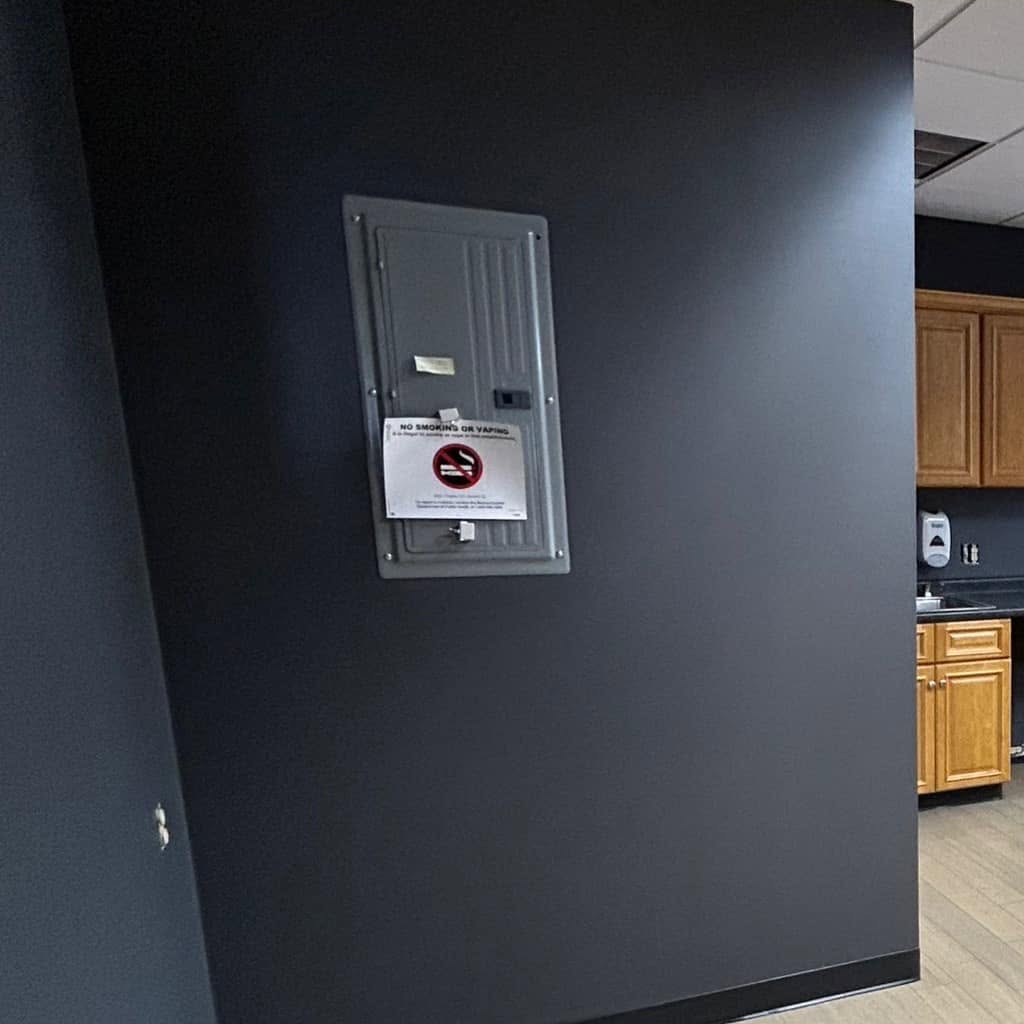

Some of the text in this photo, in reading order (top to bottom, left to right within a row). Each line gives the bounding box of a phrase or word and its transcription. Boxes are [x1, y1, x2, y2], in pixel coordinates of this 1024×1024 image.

[400, 423, 510, 435] NO SMOKING OR VAPING
